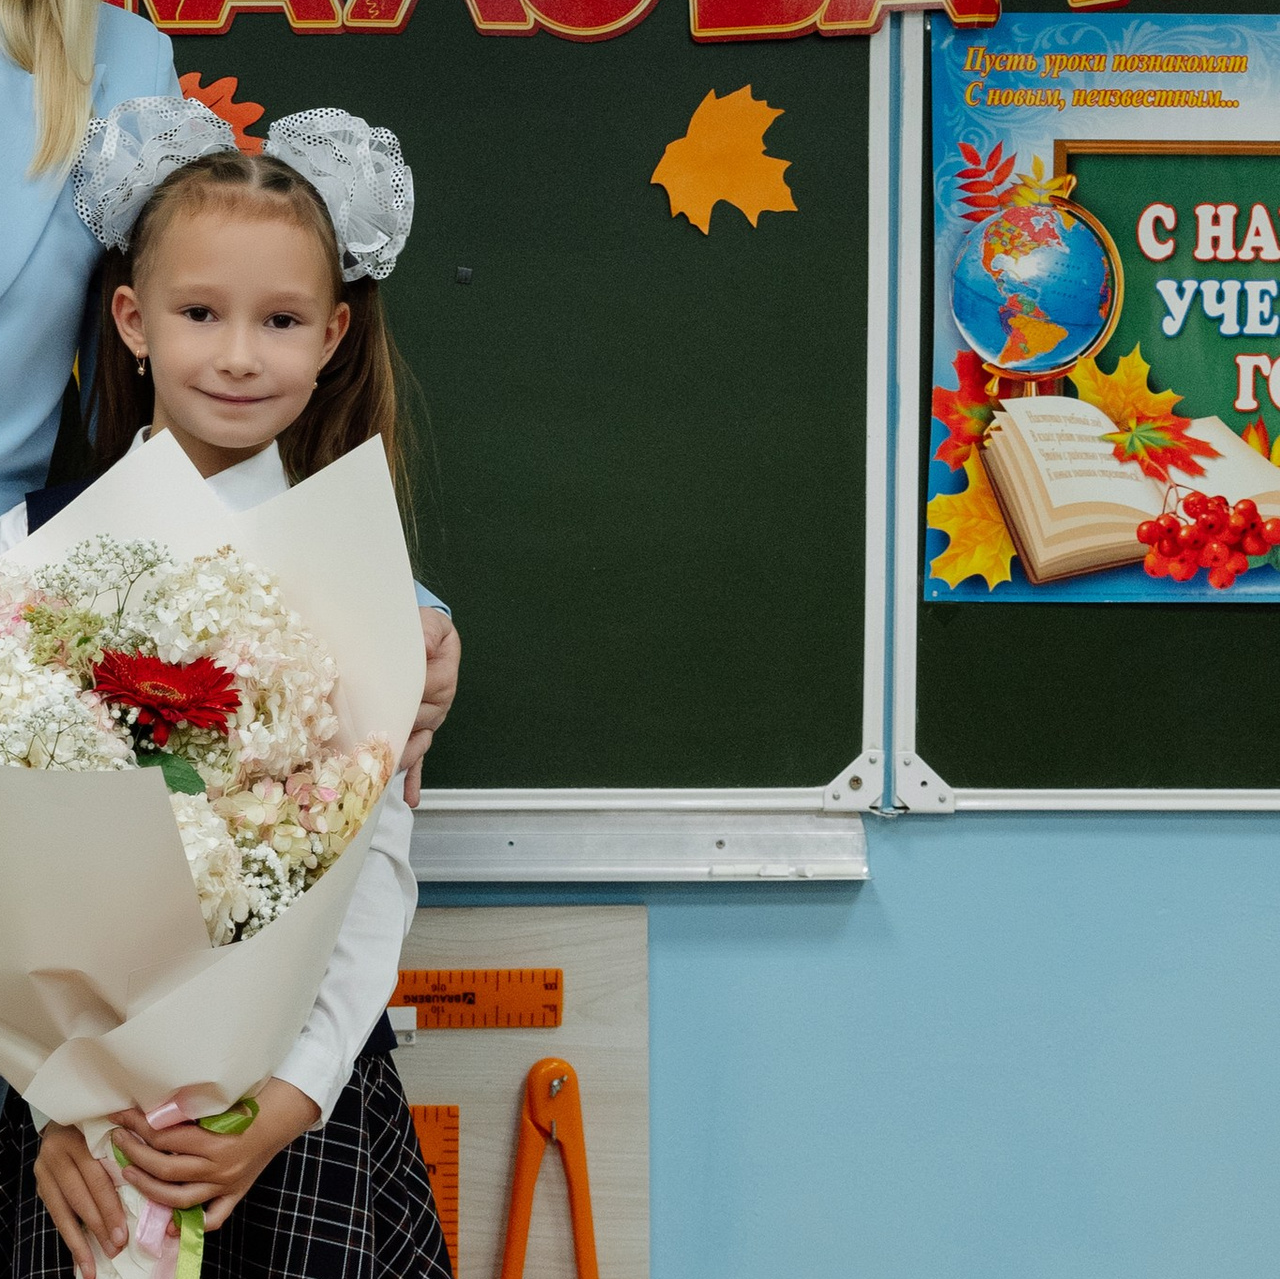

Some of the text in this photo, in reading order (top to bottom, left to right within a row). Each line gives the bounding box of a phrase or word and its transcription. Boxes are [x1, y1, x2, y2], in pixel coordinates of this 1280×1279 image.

[962, 45, 1248, 78] Пусть уроки познакомят
[963, 80, 1240, 110] С новым, неизвестным...
[1137, 201, 1177, 262] С
[1233, 353, 1280, 411] Г
[403, 994, 462, 1005] BRAUBERG
